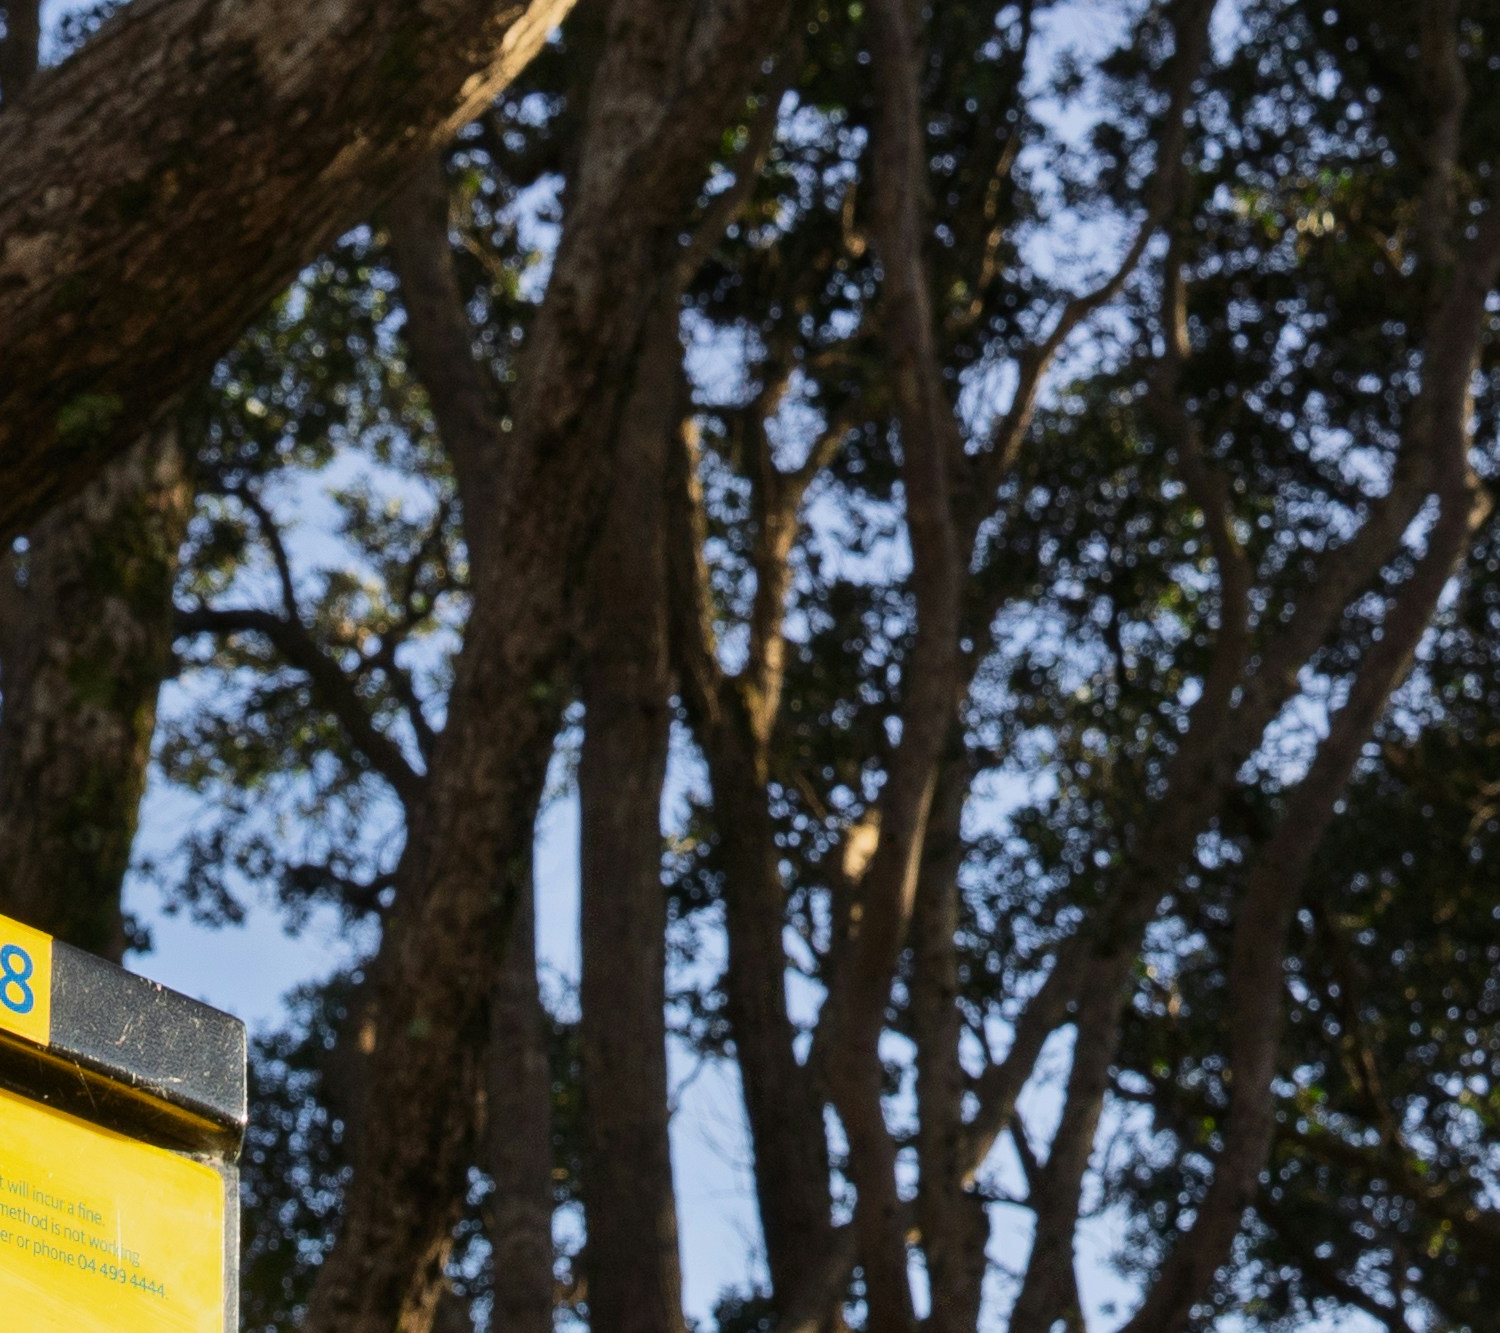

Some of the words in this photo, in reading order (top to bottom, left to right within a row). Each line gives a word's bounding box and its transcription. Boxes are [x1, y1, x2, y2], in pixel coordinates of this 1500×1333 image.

[8, 1180, 29, 1199] will
[32, 1185, 64, 1212] incur
[67, 1202, 75, 1215] a
[78, 1202, 106, 1227] fine.
[16, 1234, 31, 1249] or
[33, 1240, 75, 1266] phone
[77, 1253, 96, 1272] 04
[99, 1263, 127, 1284] 499
[51, 1217, 61, 1236] is
[64, 1227, 85, 1244] not
[89, 1236, 141, 1268] working
